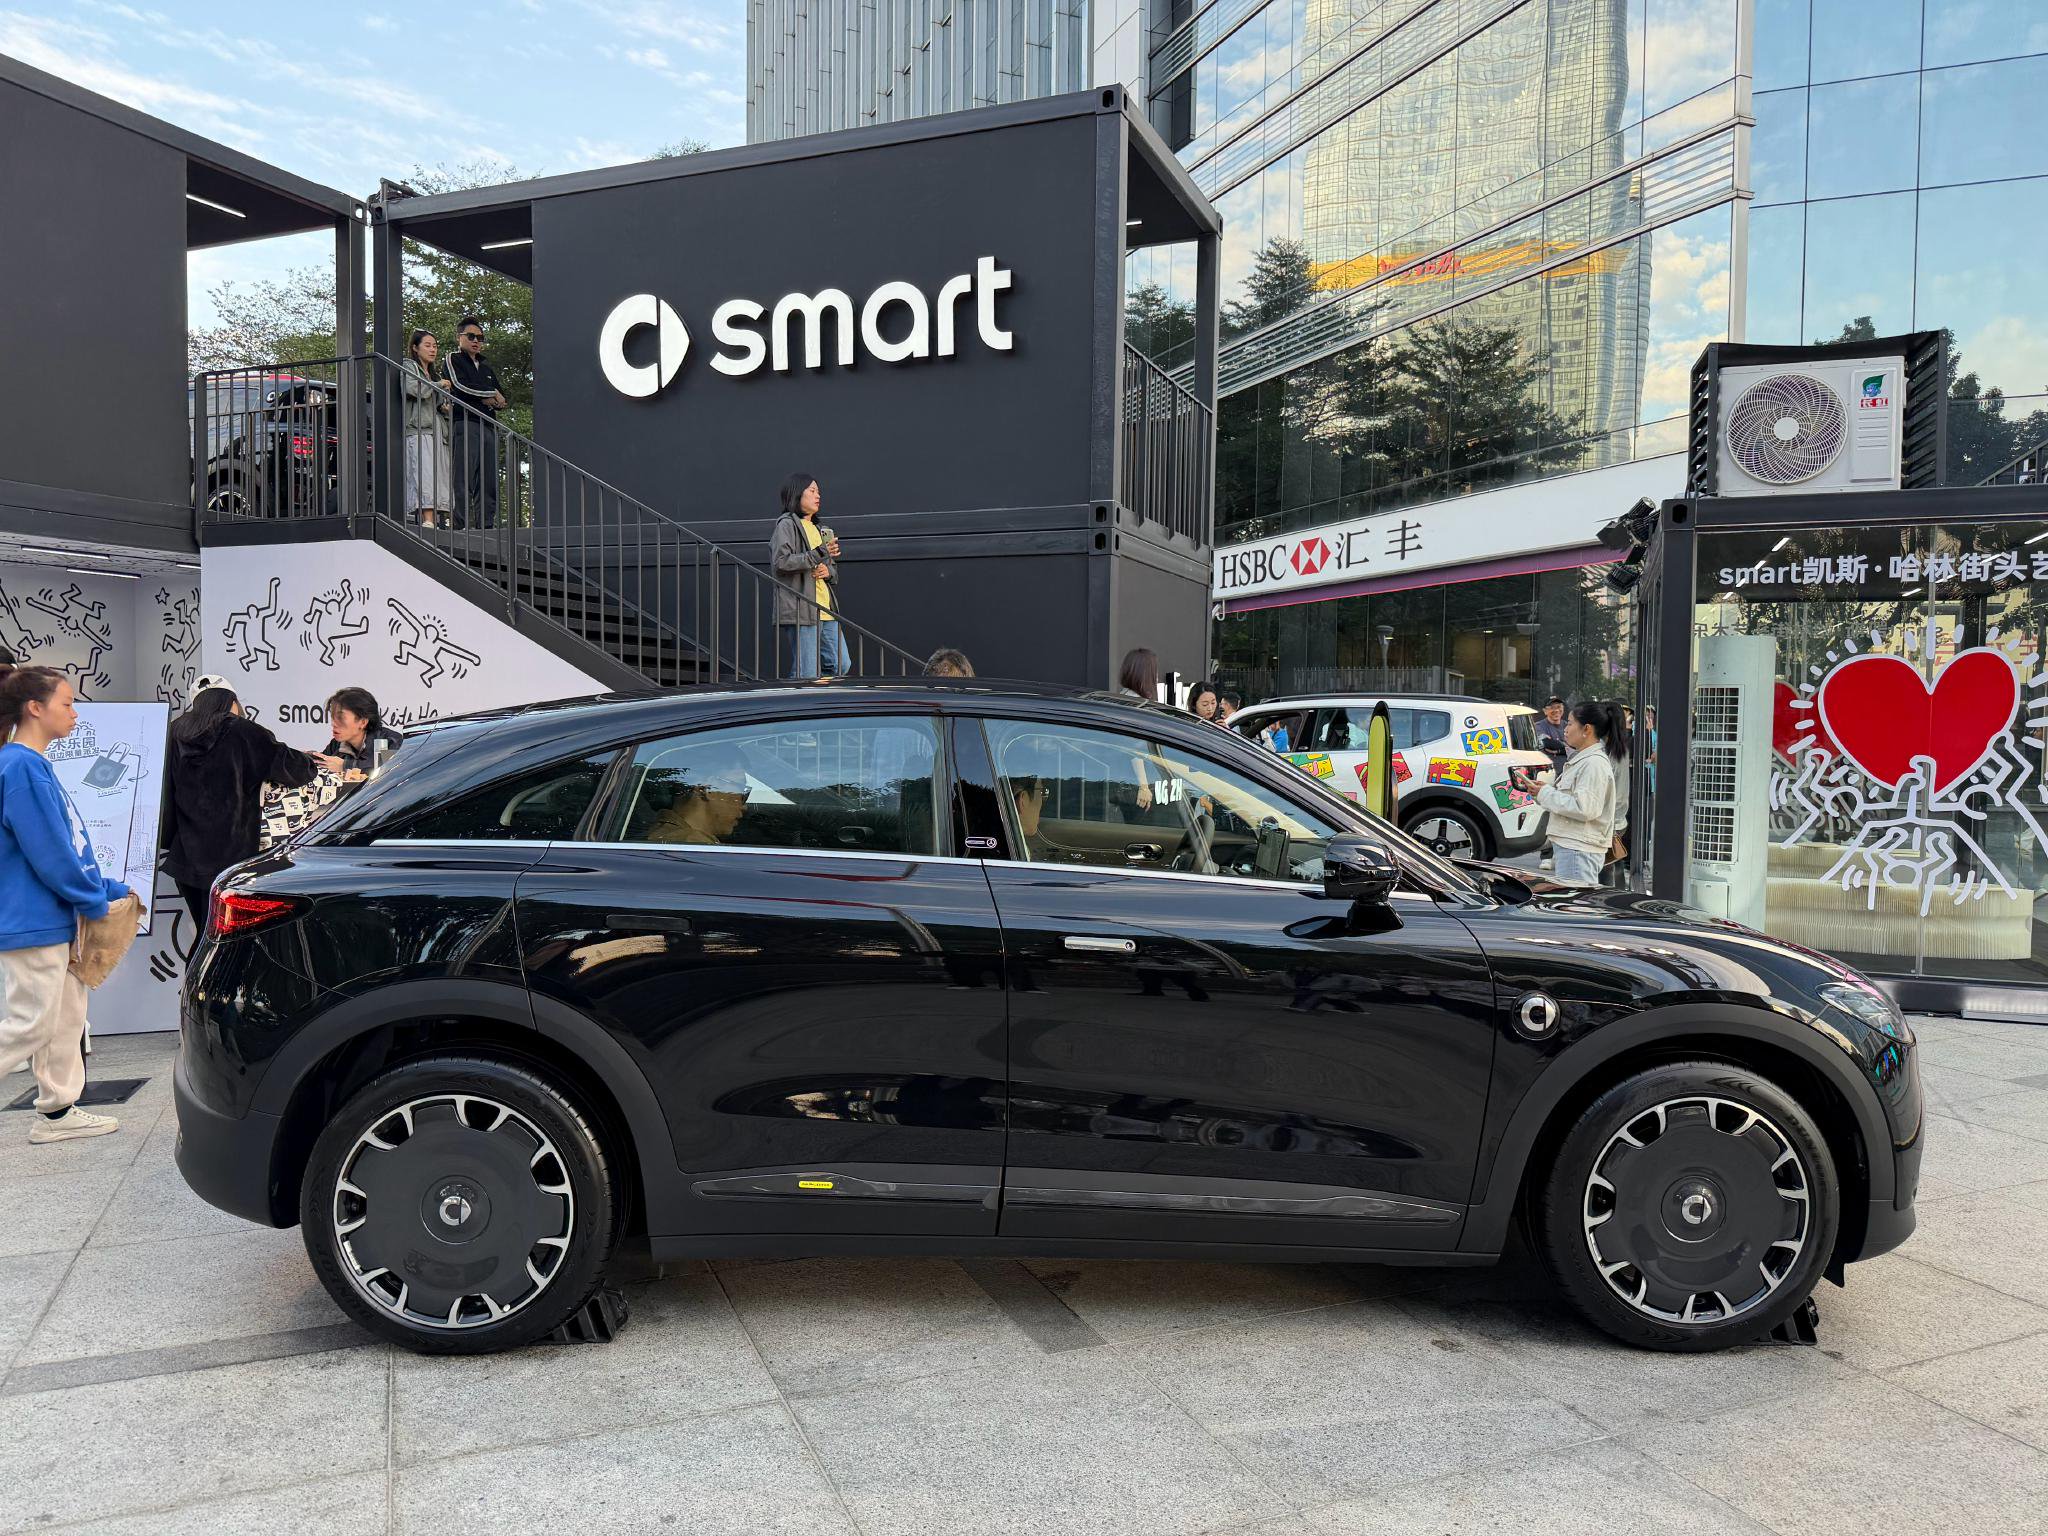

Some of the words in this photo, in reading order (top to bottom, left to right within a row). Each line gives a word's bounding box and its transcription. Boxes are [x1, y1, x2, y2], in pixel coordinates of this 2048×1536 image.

[710, 255, 1013, 376] smart
[1220, 543, 1287, 589] HSBC
[1335, 519, 1424, 570] 汇丰
[278, 704, 331, 724] smar
[49, 737, 96, 751] 术乐园
